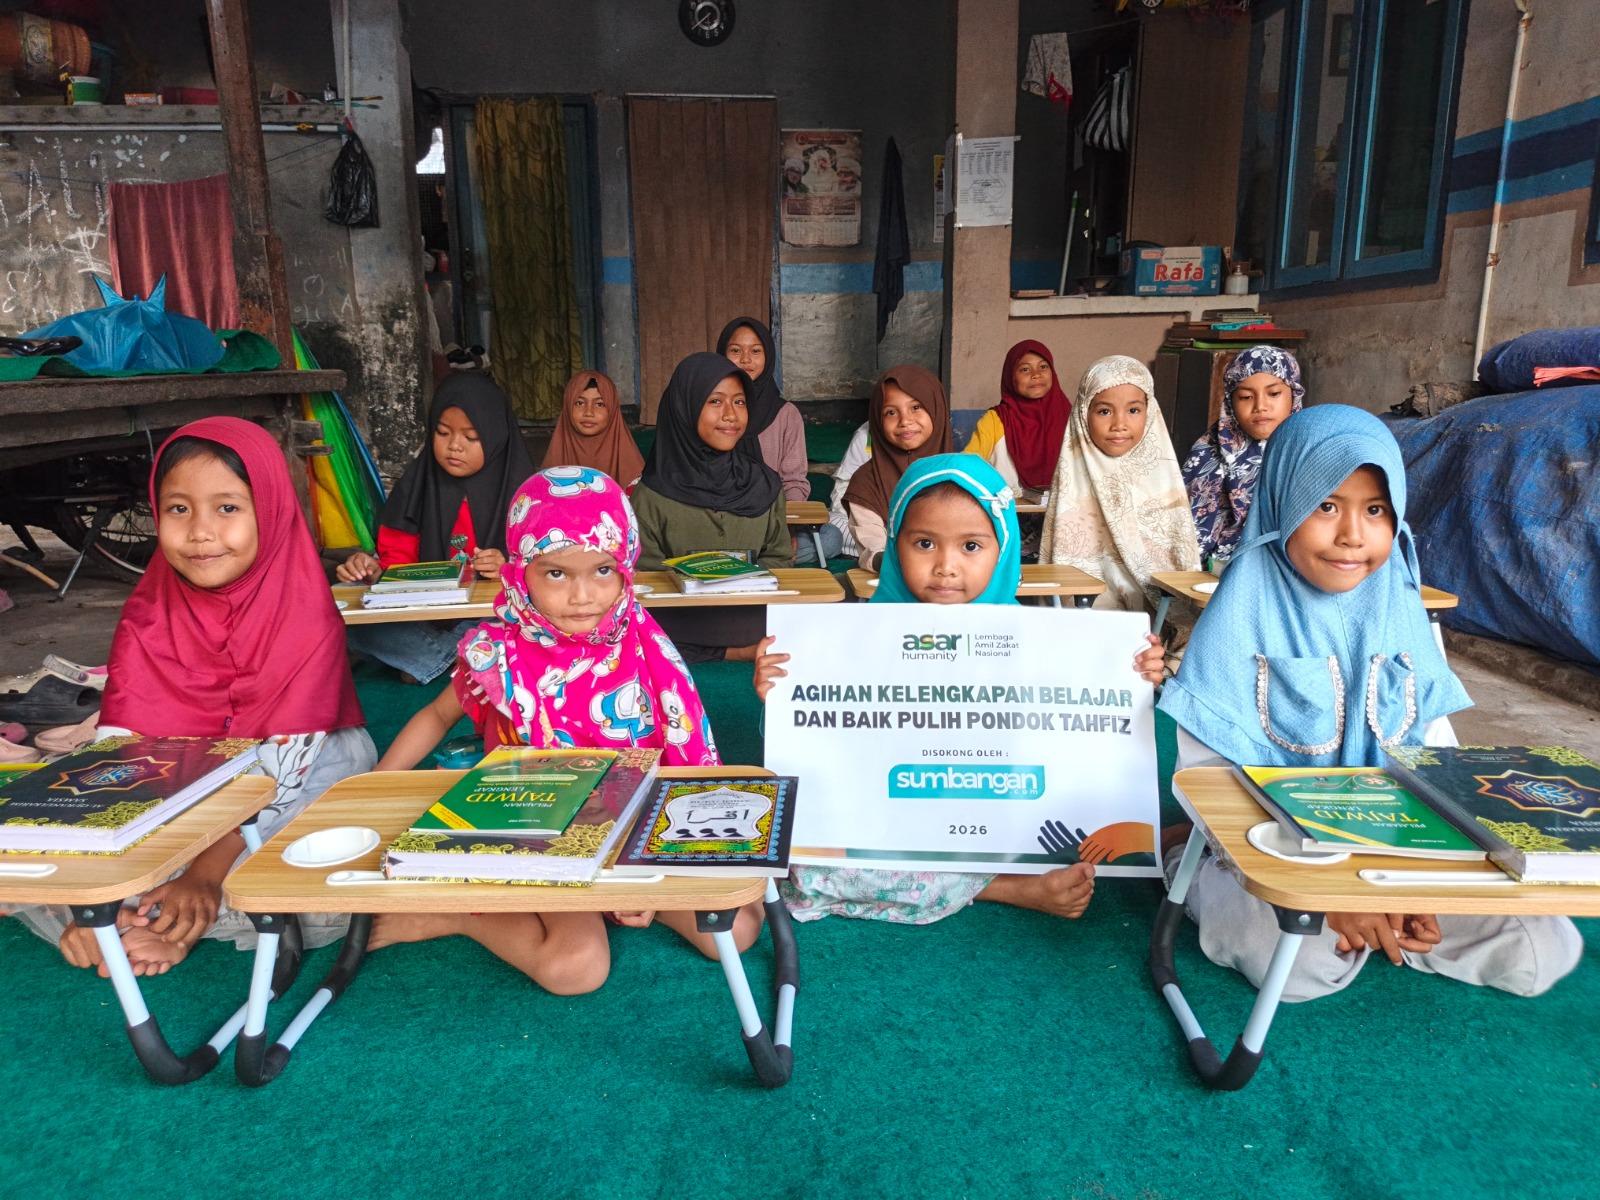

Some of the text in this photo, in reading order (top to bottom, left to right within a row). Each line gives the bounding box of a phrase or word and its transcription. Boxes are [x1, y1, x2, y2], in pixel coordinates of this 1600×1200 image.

[1154, 263, 1204, 281] Rafa
[902, 634, 962, 651] asar
[974, 633, 1014, 642] Lembaga
[902, 651, 957, 662] humanity
[791, 684, 1133, 707] AGIHAN KELENGKAPAN BELAJAR
[794, 710, 1132, 735] DAN BAIK PULIH PONDOK TAHFIZ
[922, 749, 973, 757] DISOKONG
[976, 749, 1002, 757] OLEH
[896, 767, 1038, 795] sumbangan
[466, 790, 557, 802] TAJWID
[1314, 810, 1419, 822] TAJWID
[949, 824, 988, 835] 2026
